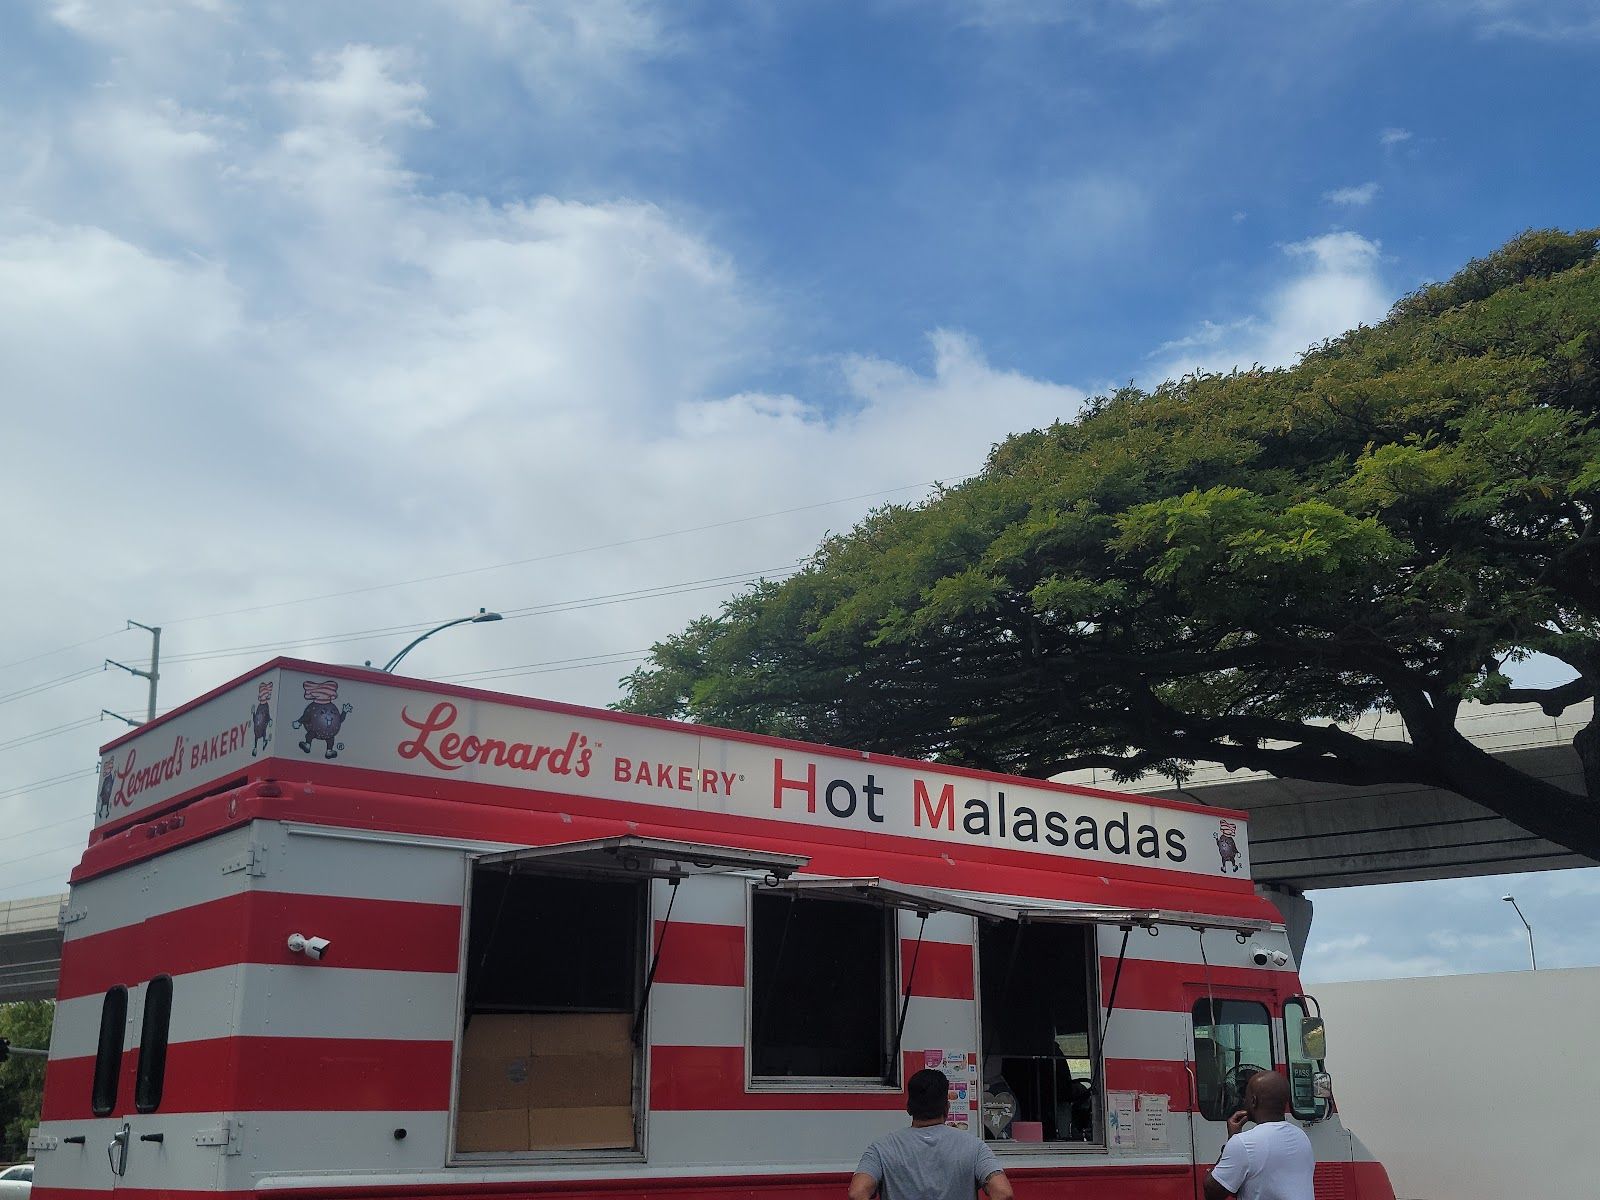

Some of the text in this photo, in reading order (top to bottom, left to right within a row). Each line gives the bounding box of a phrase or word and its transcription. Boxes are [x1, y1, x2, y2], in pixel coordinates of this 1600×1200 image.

[190, 721, 249, 770] BAKERY
[397, 702, 737, 796] Leonard's BAKERY
[773, 758, 1188, 863] Hot Malasadas
